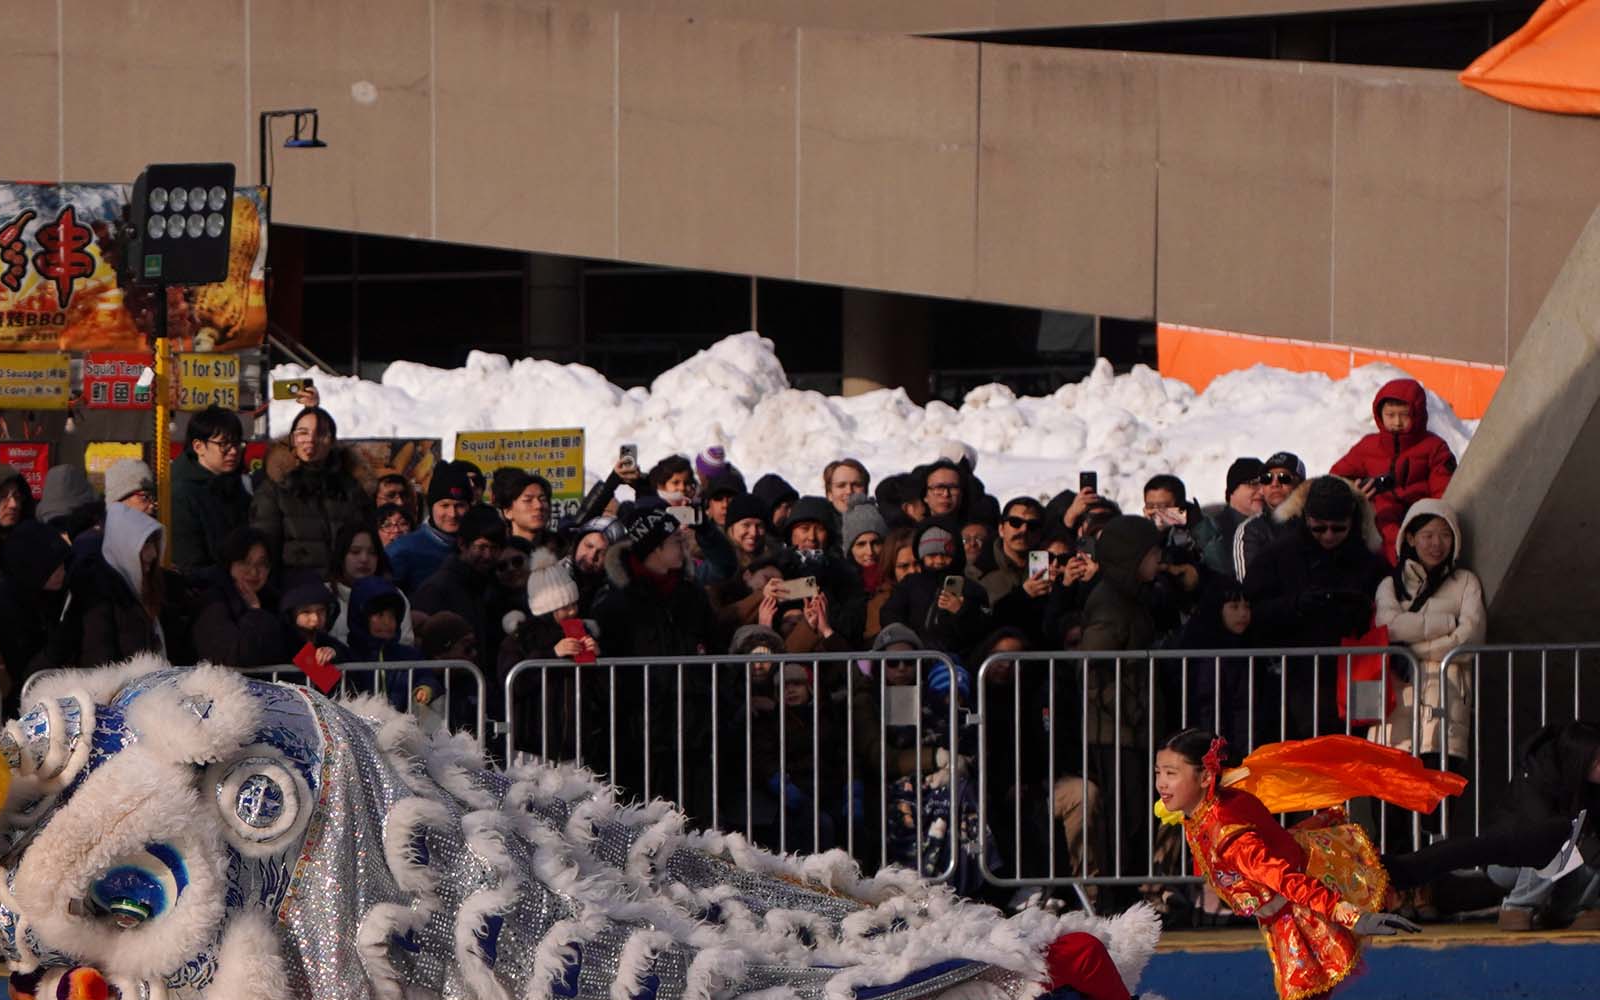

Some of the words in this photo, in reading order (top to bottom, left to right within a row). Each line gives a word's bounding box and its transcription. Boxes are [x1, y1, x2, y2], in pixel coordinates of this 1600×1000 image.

[86, 360, 115, 376] Squid
[182, 360, 189, 377] 1
[192, 359, 210, 377] for
[214, 360, 236, 377] $10
[180, 387, 189, 405] 2
[192, 386, 210, 404] for
[214, 388, 236, 407] $15
[461, 439, 496, 451] Squid
